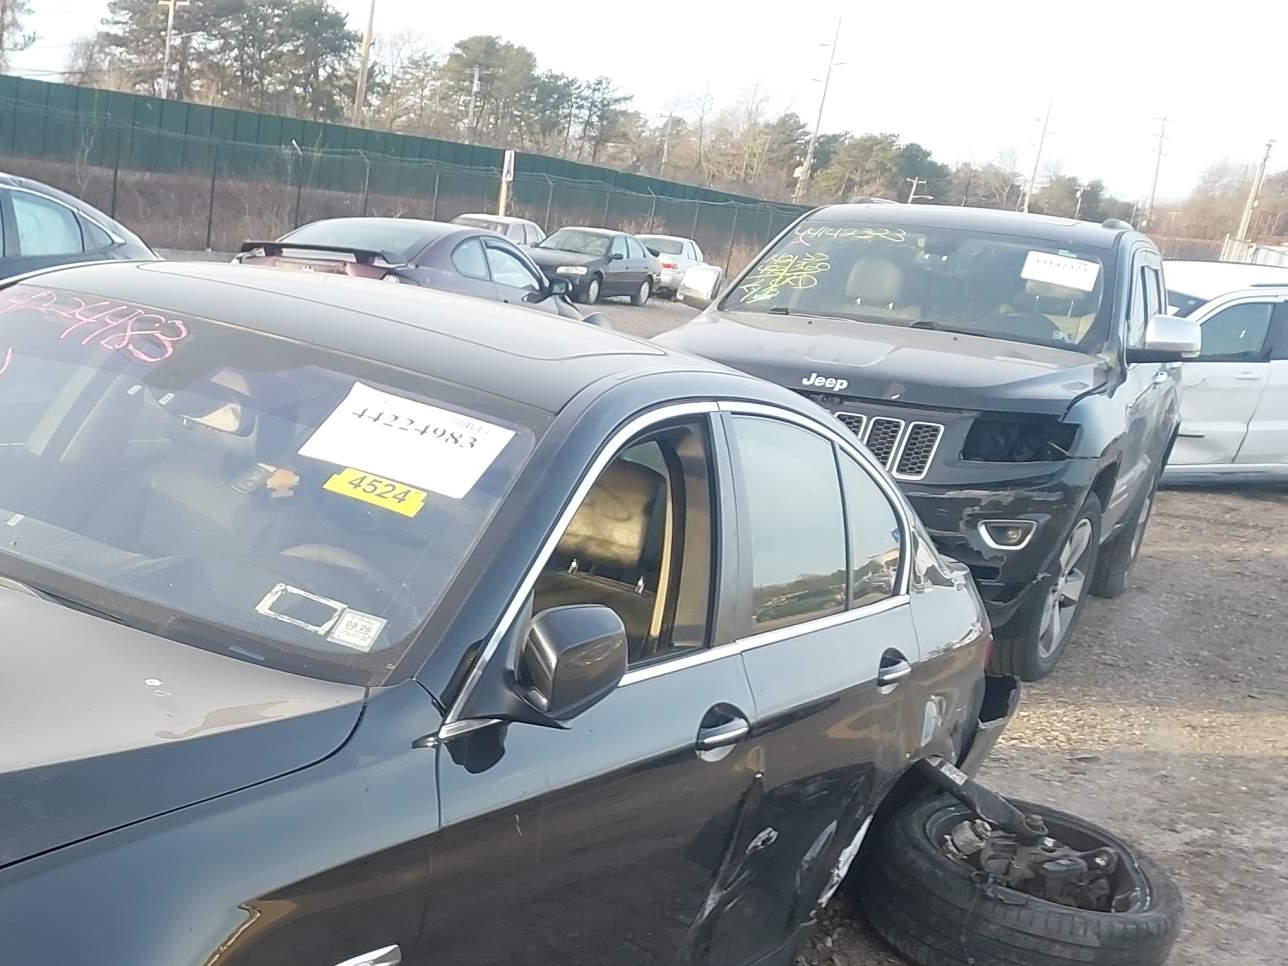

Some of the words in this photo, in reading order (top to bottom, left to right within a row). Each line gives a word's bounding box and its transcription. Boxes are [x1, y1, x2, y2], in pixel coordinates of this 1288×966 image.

[802, 372, 848, 391] Jeep
[351, 407, 478, 449] 44224983
[347, 475, 411, 503] 4524
